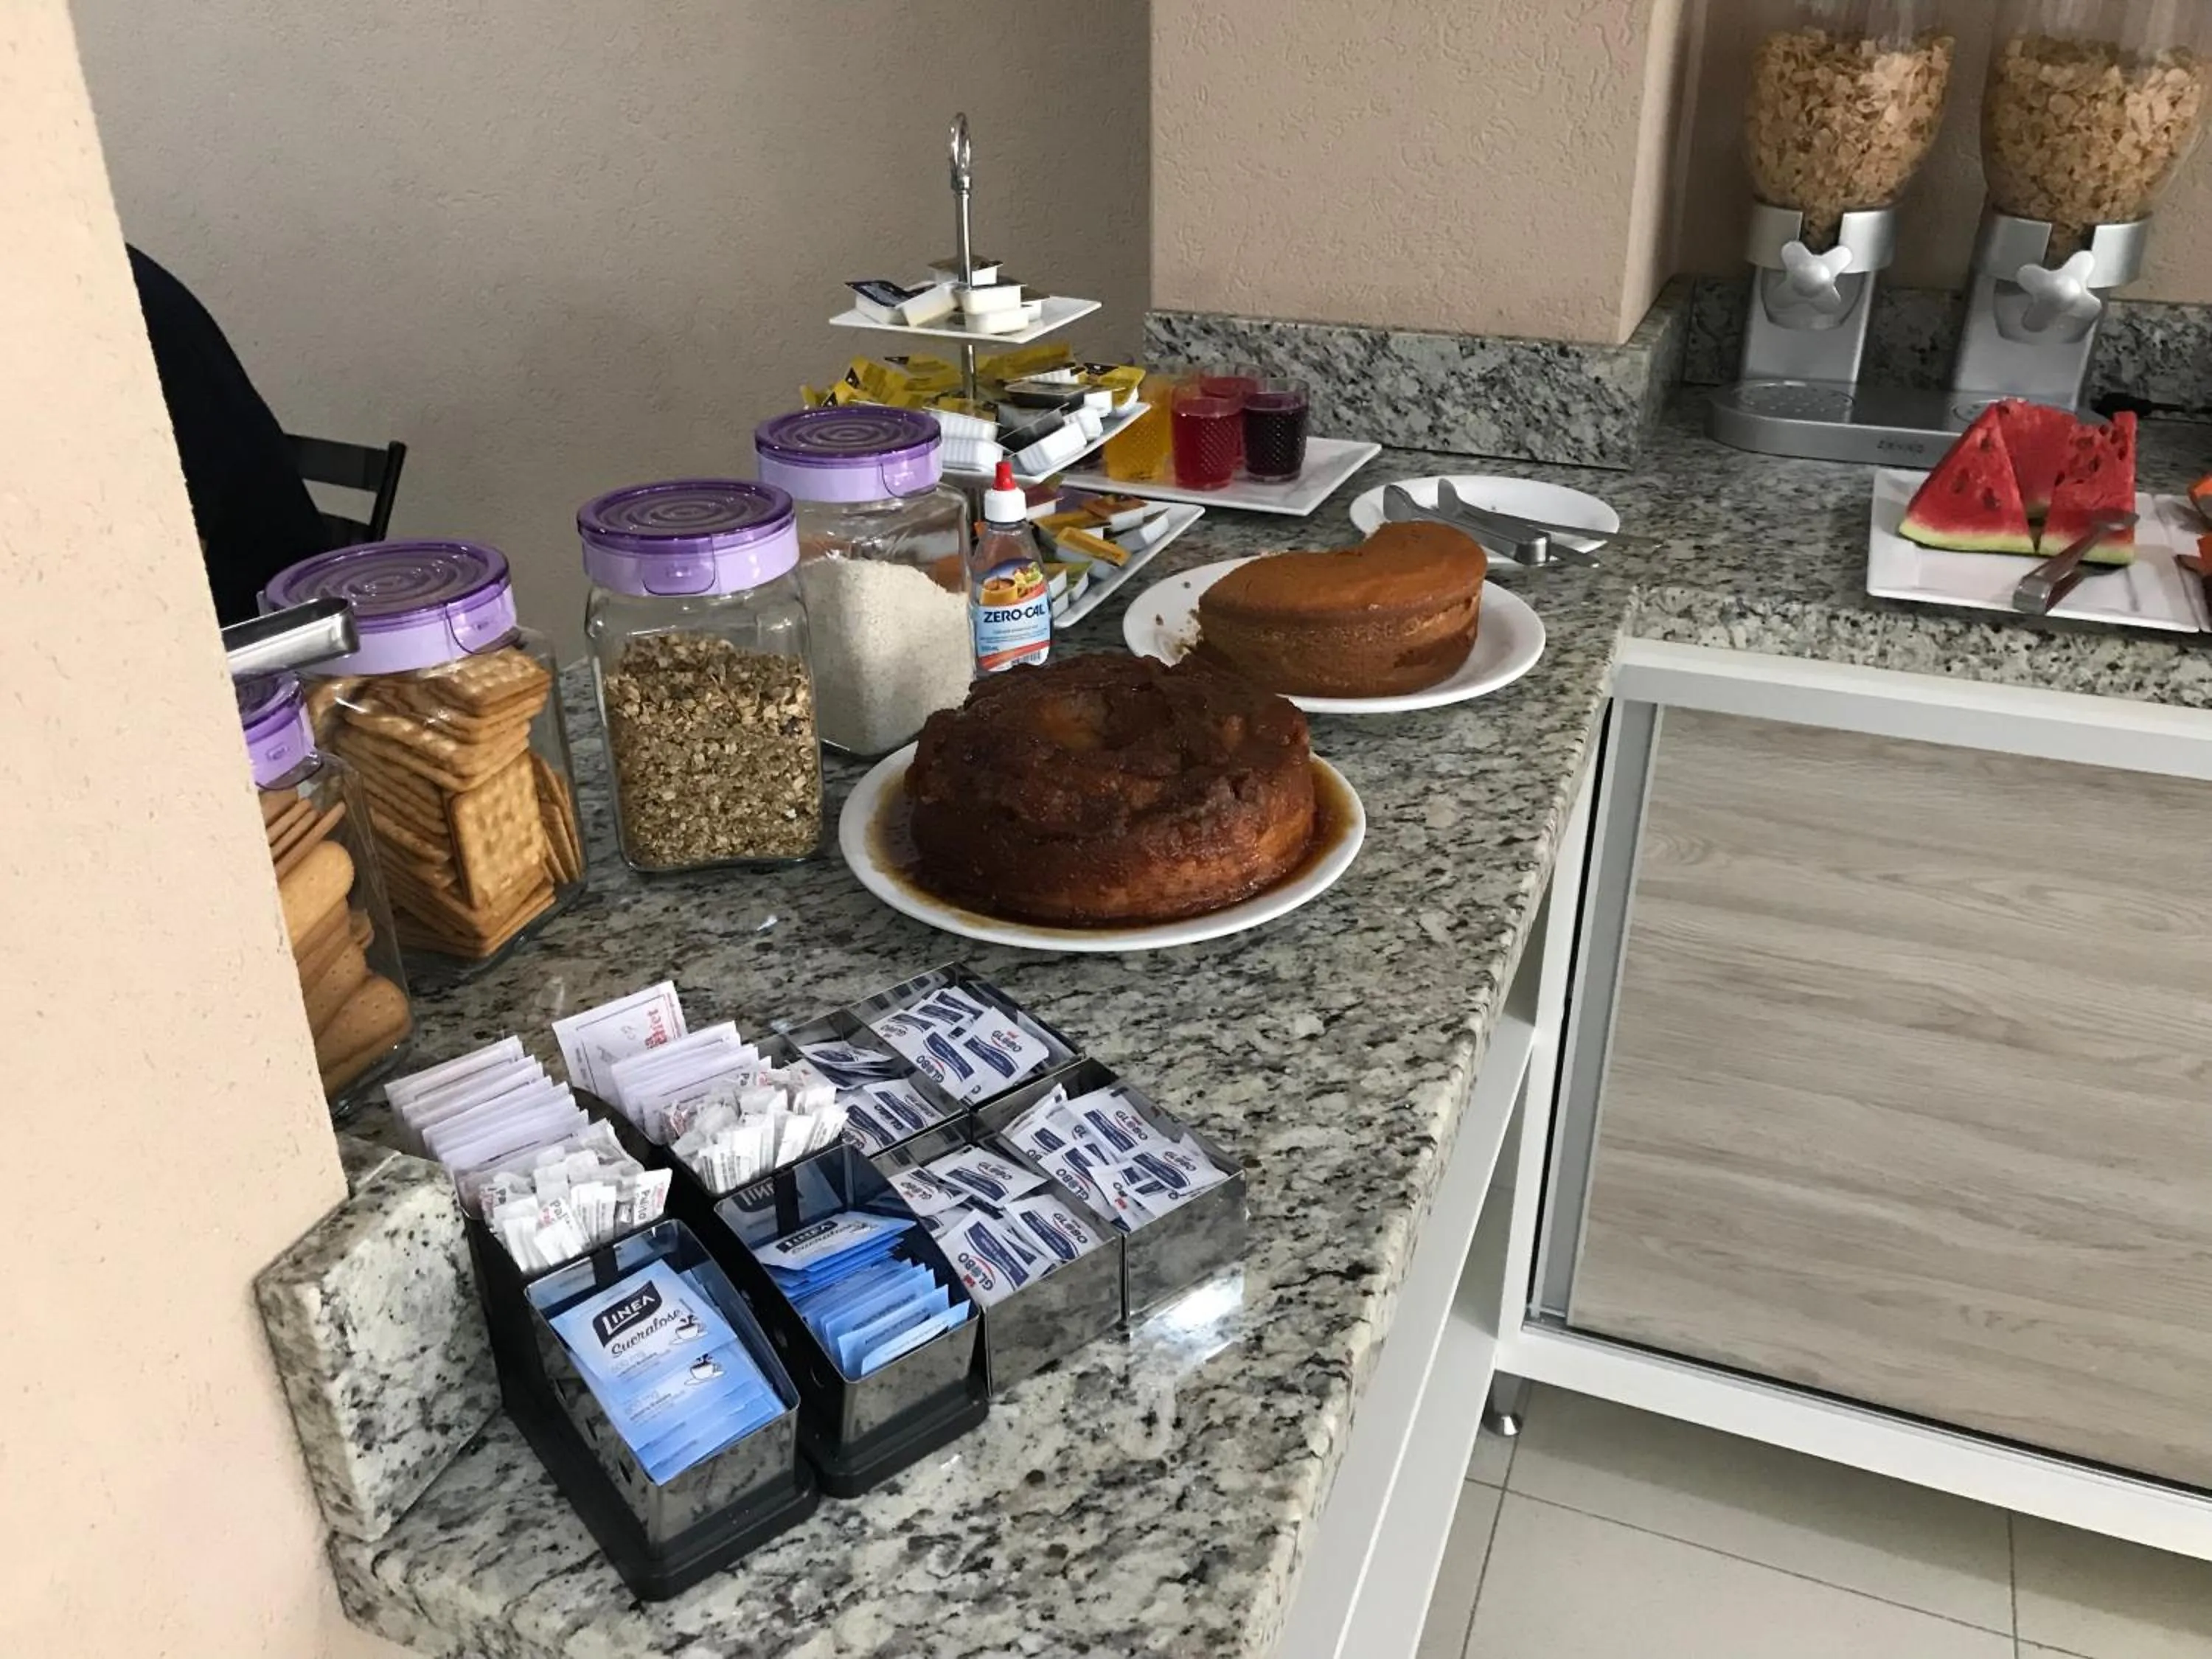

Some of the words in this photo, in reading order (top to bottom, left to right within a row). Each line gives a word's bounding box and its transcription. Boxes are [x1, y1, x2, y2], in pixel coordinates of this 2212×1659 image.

[983, 604, 1046, 623] ZERO-CAL
[991, 1030, 1023, 1053] GLOBO
[1115, 1110, 1149, 1141] GLOBO
[1055, 1168, 1090, 1201] GLOBO
[1053, 1212, 1088, 1245] GLOBO
[958, 1251, 994, 1292] GLOBO
[601, 1293, 656, 1337] LINEA
[611, 1307, 681, 1359] Sucralose
